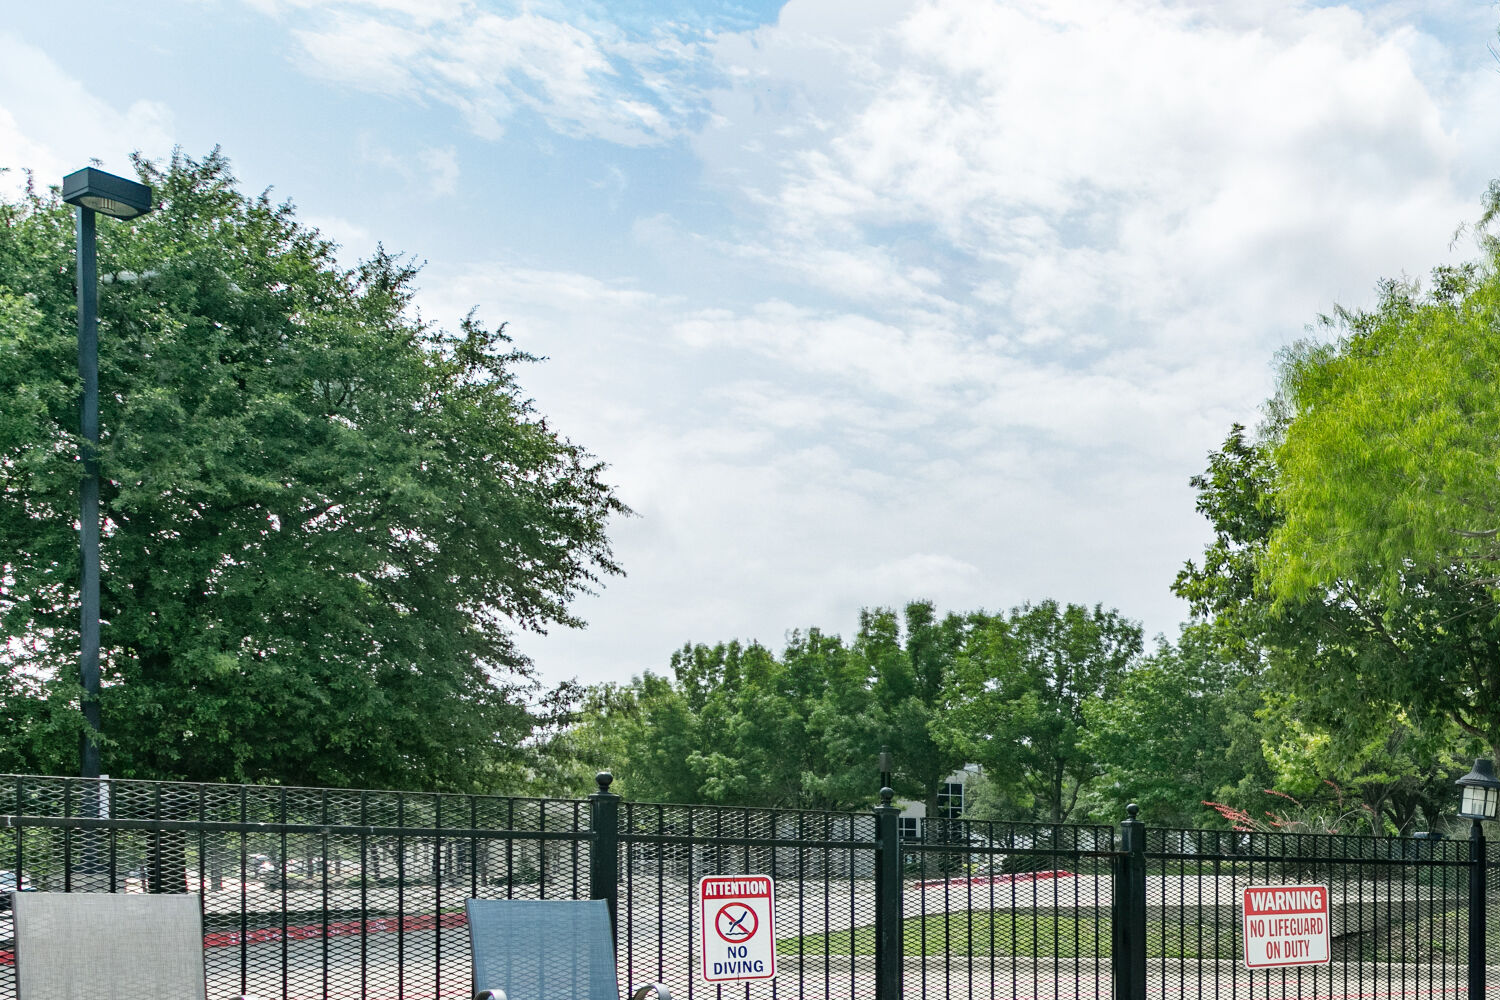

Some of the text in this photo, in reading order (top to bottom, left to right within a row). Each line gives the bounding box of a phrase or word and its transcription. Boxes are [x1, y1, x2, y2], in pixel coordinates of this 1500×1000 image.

[705, 880, 767, 896] ATTENTION
[1250, 890, 1322, 912] WARNING
[1250, 917, 1323, 938] NO LIFEGUARD
[727, 945, 748, 959] NO
[1266, 939, 1310, 960] ON DUTY
[713, 960, 764, 975] DIVING
